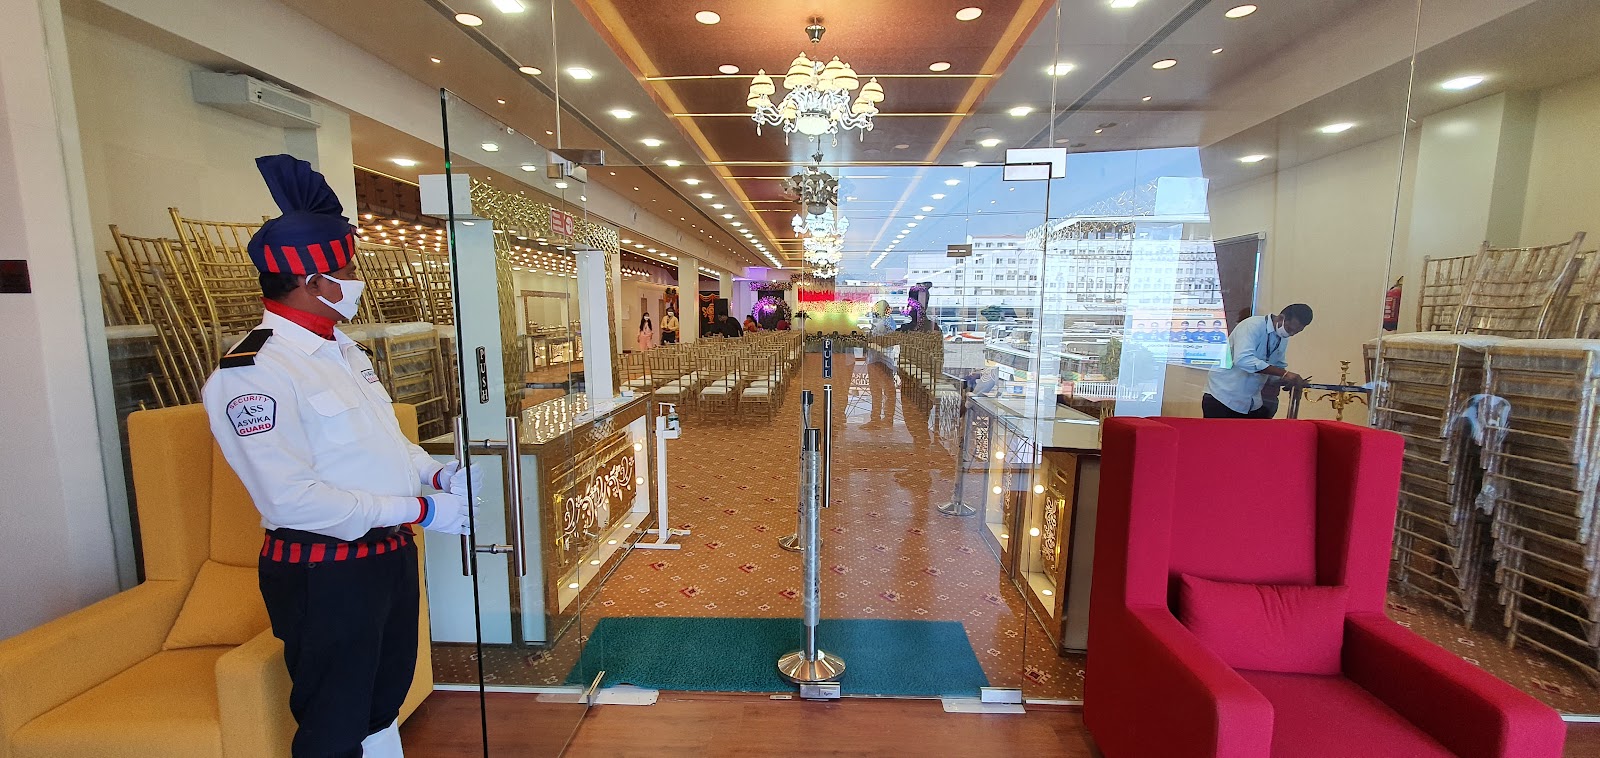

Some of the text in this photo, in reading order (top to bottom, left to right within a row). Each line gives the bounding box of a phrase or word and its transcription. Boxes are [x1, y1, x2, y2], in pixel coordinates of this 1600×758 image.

[480, 349, 488, 400] PUSH
[230, 395, 269, 410] SECURITY
[237, 415, 271, 428] ASVIKA
[239, 423, 271, 435] GUARD
